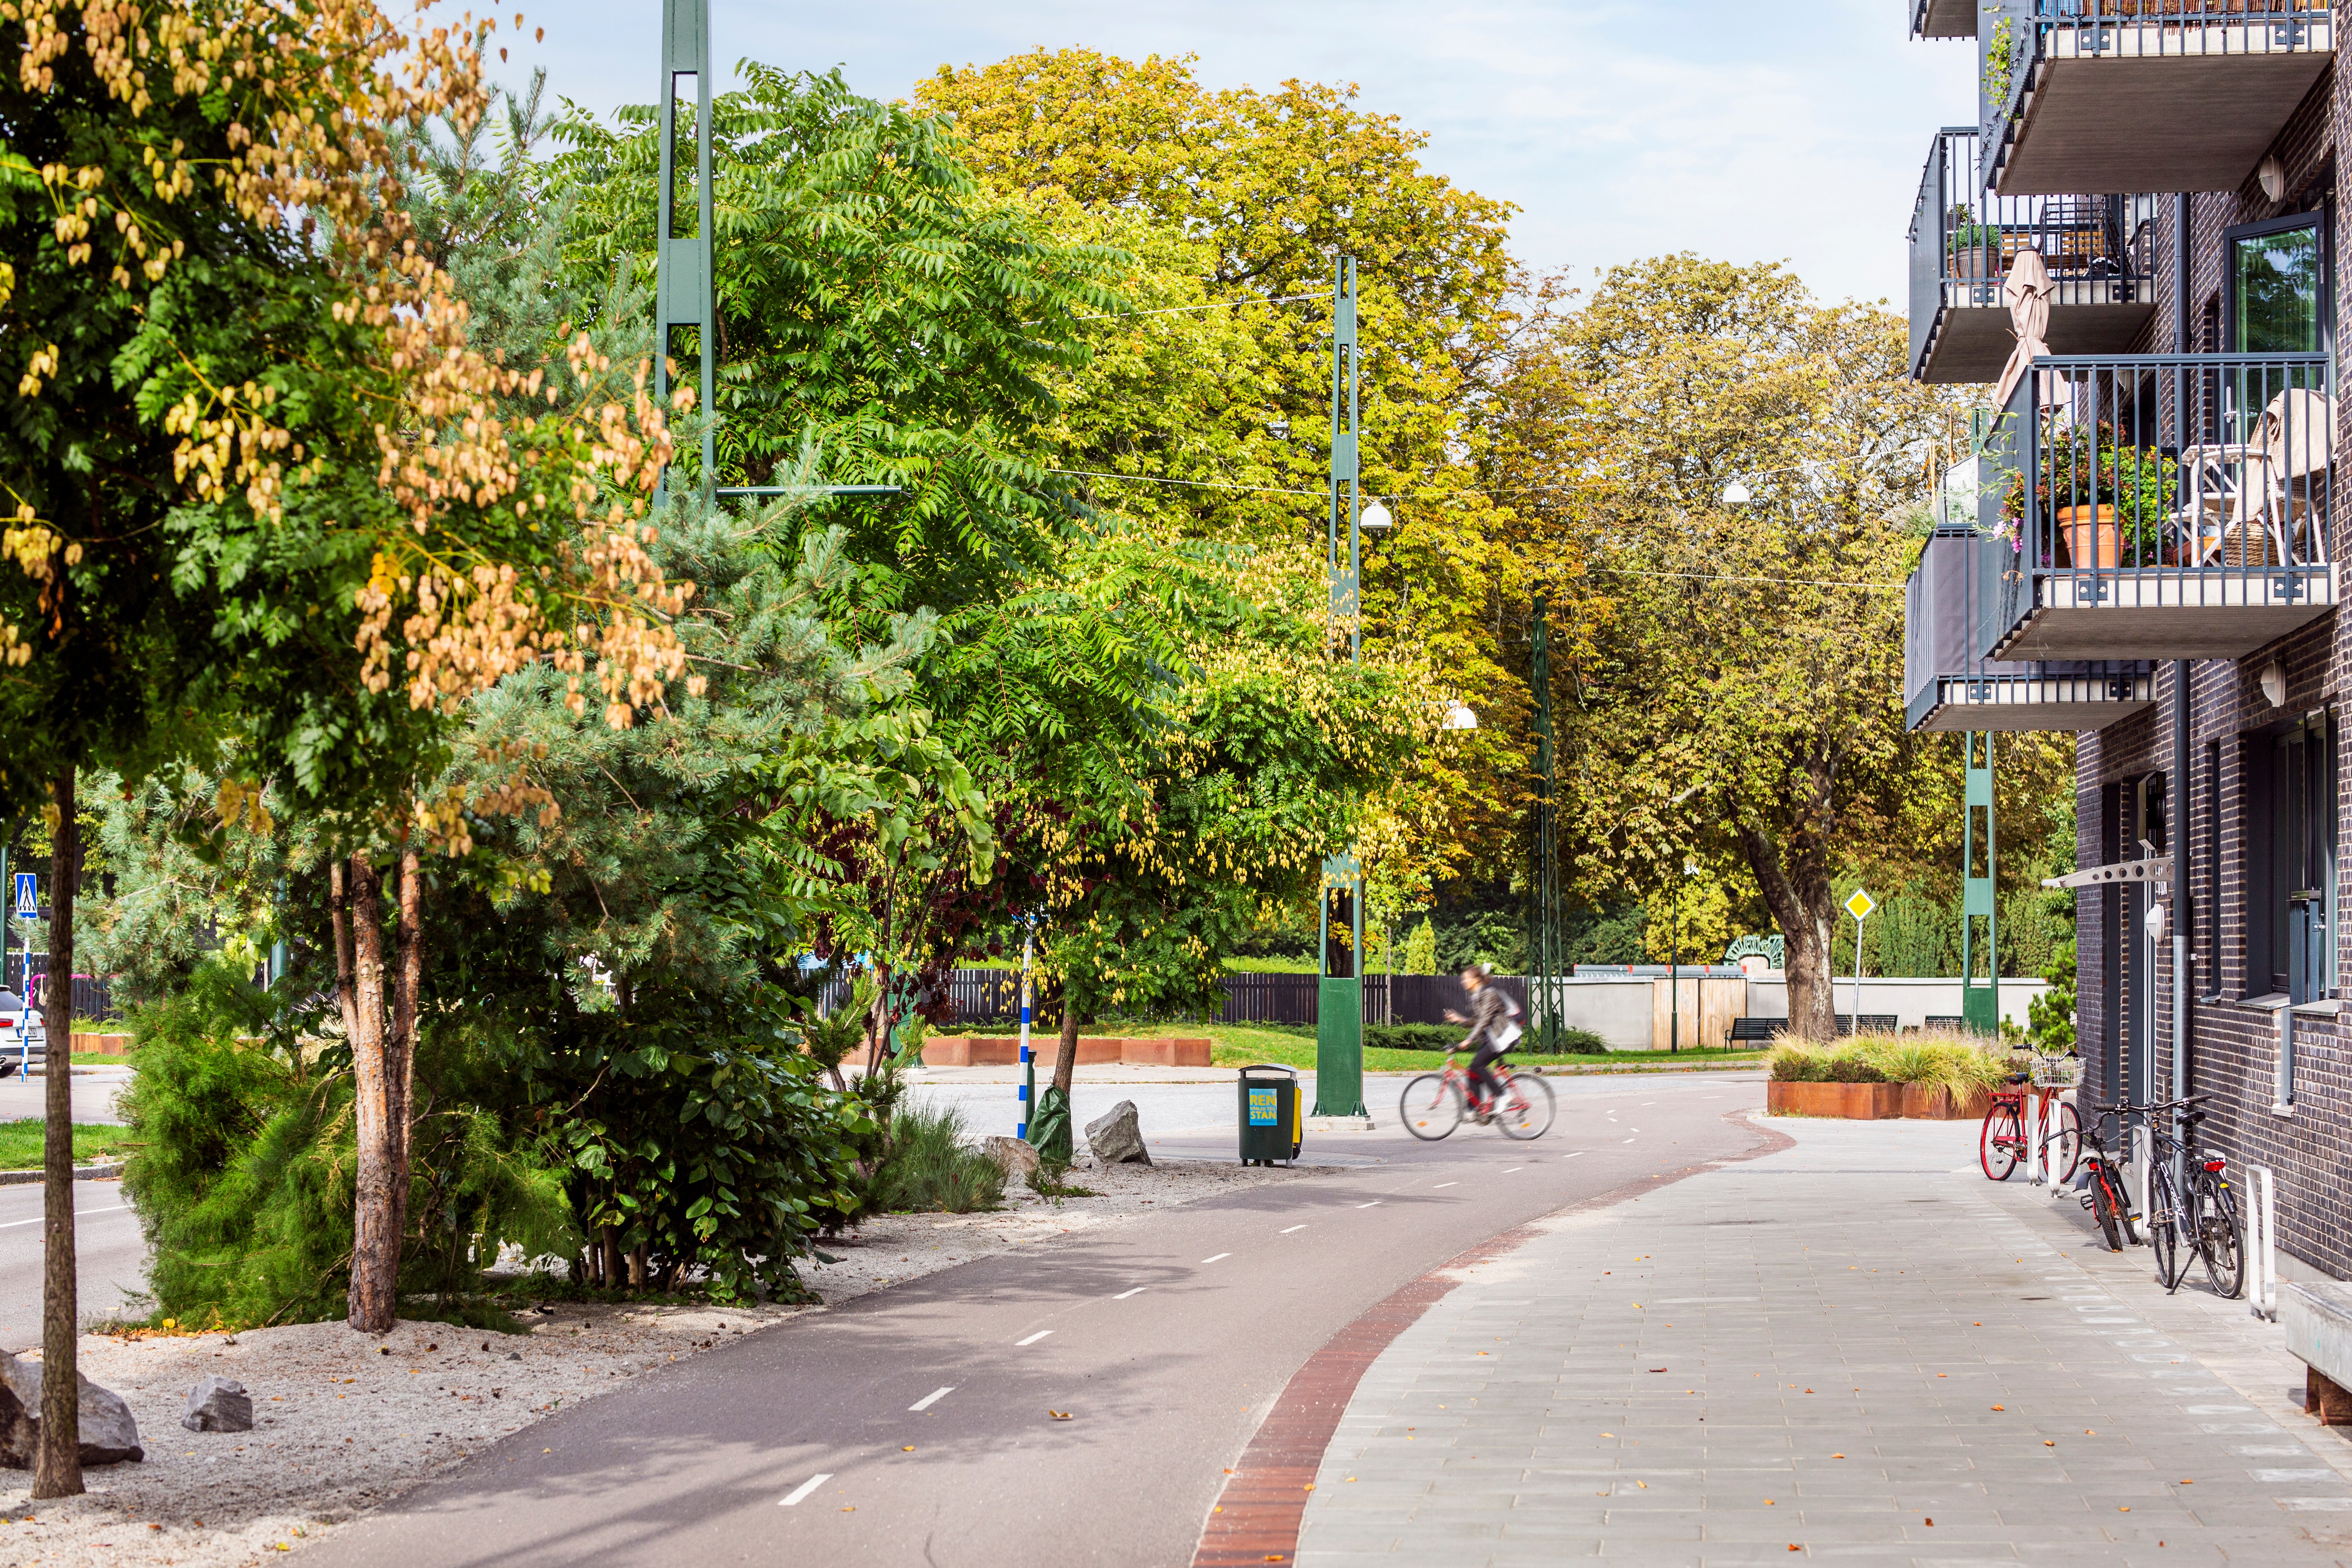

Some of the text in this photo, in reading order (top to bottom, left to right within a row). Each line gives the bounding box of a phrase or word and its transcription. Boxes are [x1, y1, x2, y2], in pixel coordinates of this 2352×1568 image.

[1250, 1095, 1276, 1106] REN
[1251, 1111, 1276, 1119] STAN
[2160, 1161, 2186, 1220] Crescent
